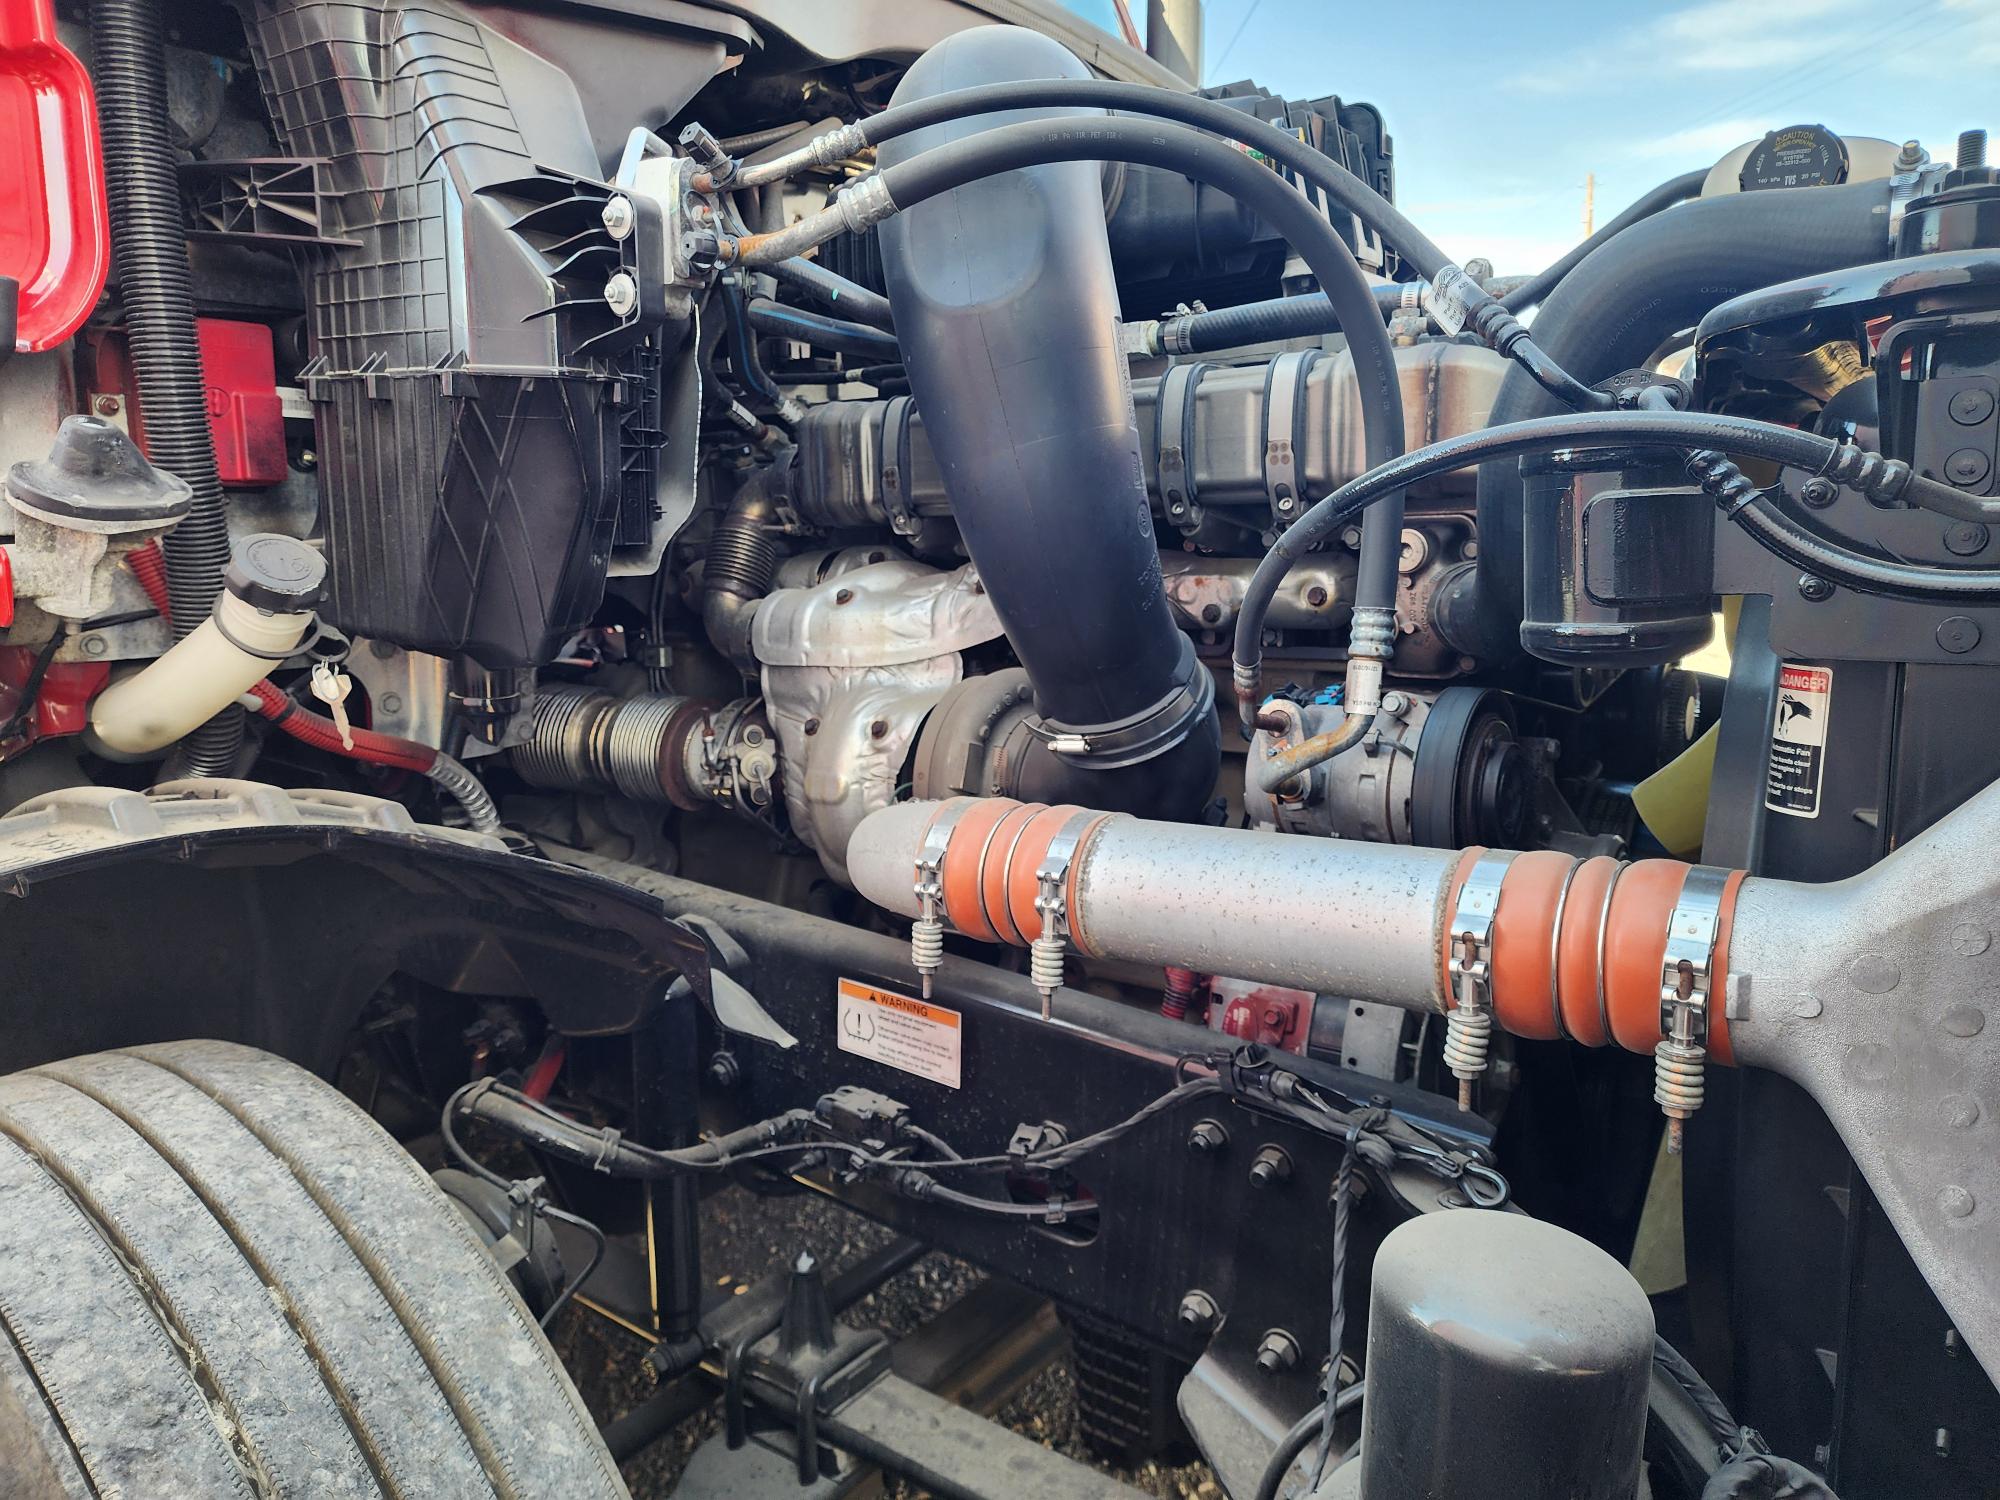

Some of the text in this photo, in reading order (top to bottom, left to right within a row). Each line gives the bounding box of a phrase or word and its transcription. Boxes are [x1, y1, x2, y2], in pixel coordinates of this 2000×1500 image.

[1782, 131, 1815, 142] CAUTION
[1784, 174, 1797, 186] TVS
[1613, 373, 1652, 387] OUT IN
[1784, 674, 1826, 691] DANGER
[1796, 748, 1810, 756] Fan
[1794, 786, 1813, 794] stops
[880, 992, 928, 1017] WARNING
